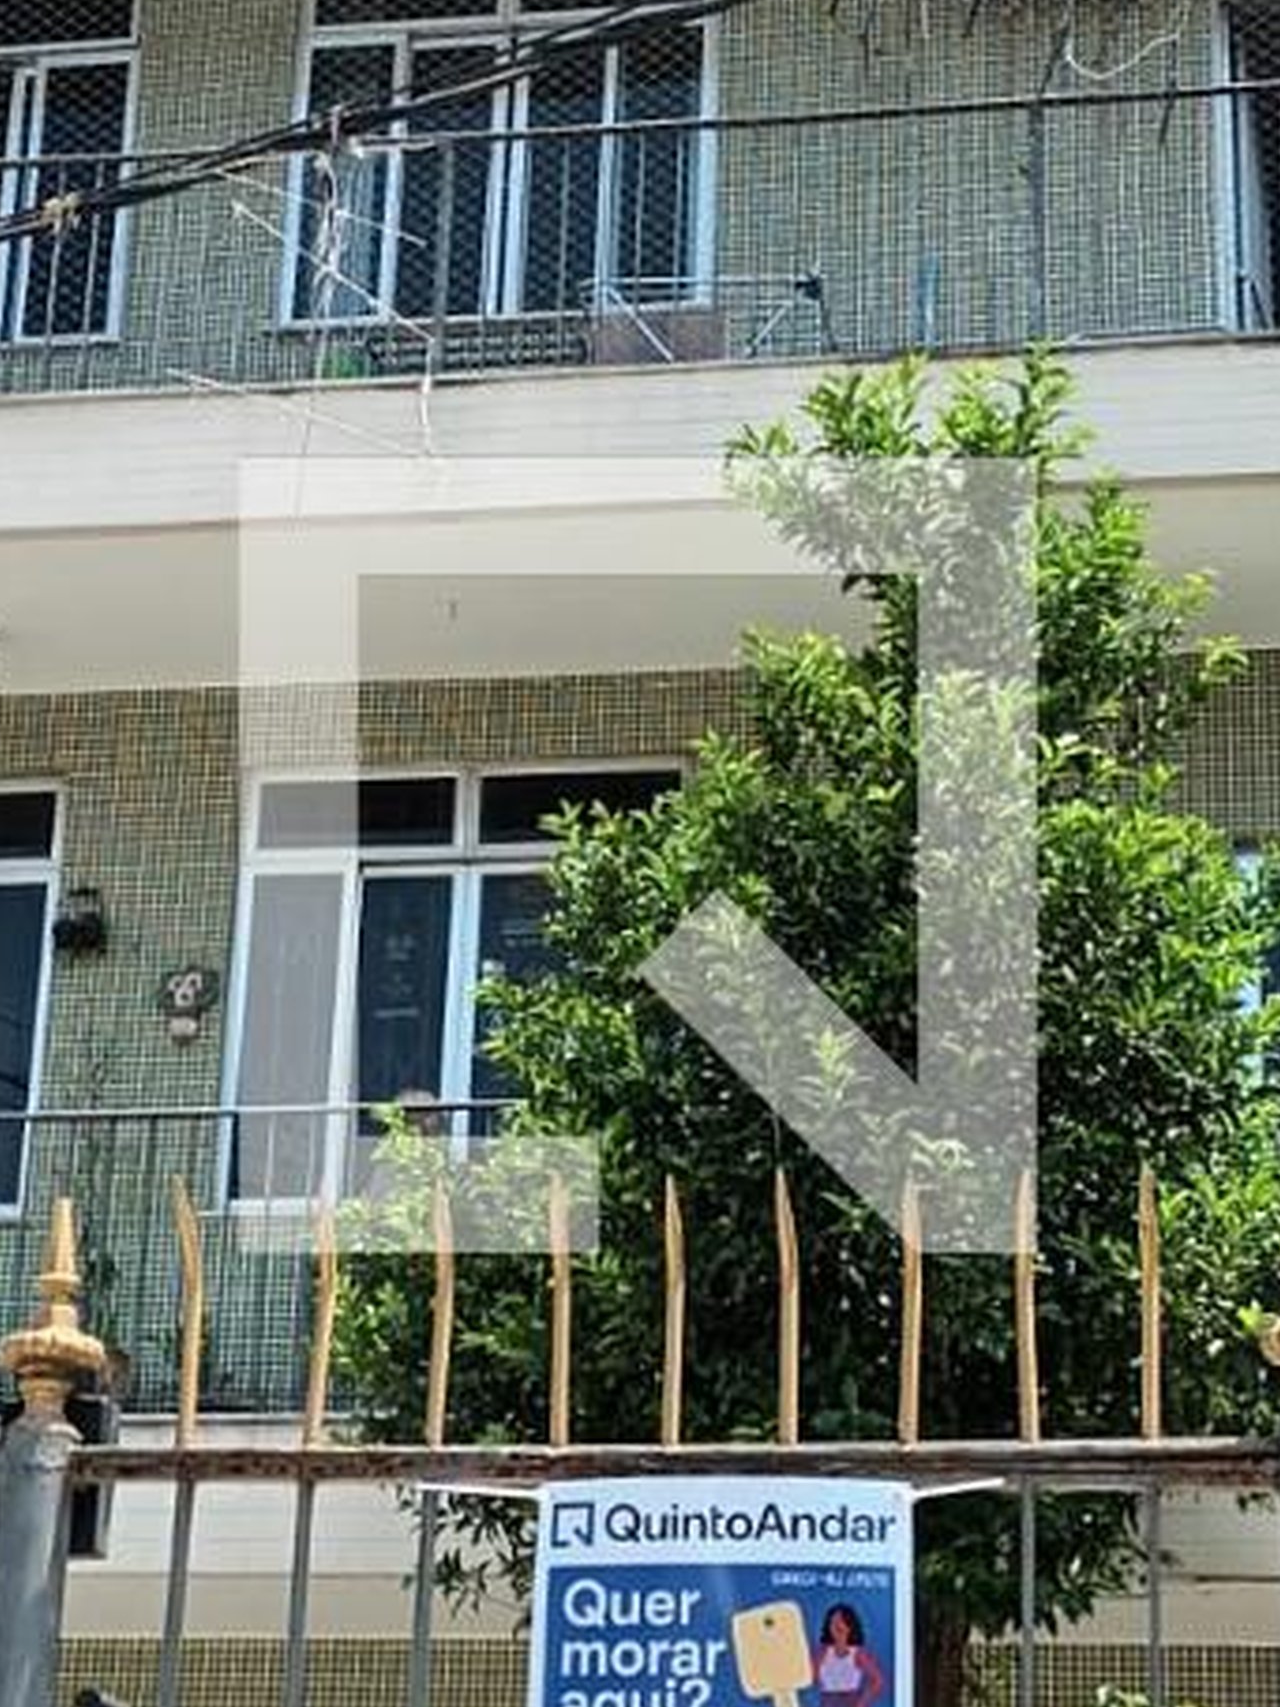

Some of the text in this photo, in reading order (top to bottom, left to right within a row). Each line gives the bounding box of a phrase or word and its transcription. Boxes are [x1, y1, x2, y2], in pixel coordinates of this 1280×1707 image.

[605, 1502, 896, 1544] QuintoAndar
[563, 1578, 702, 1629] Quer
[560, 1640, 728, 1678] morar
